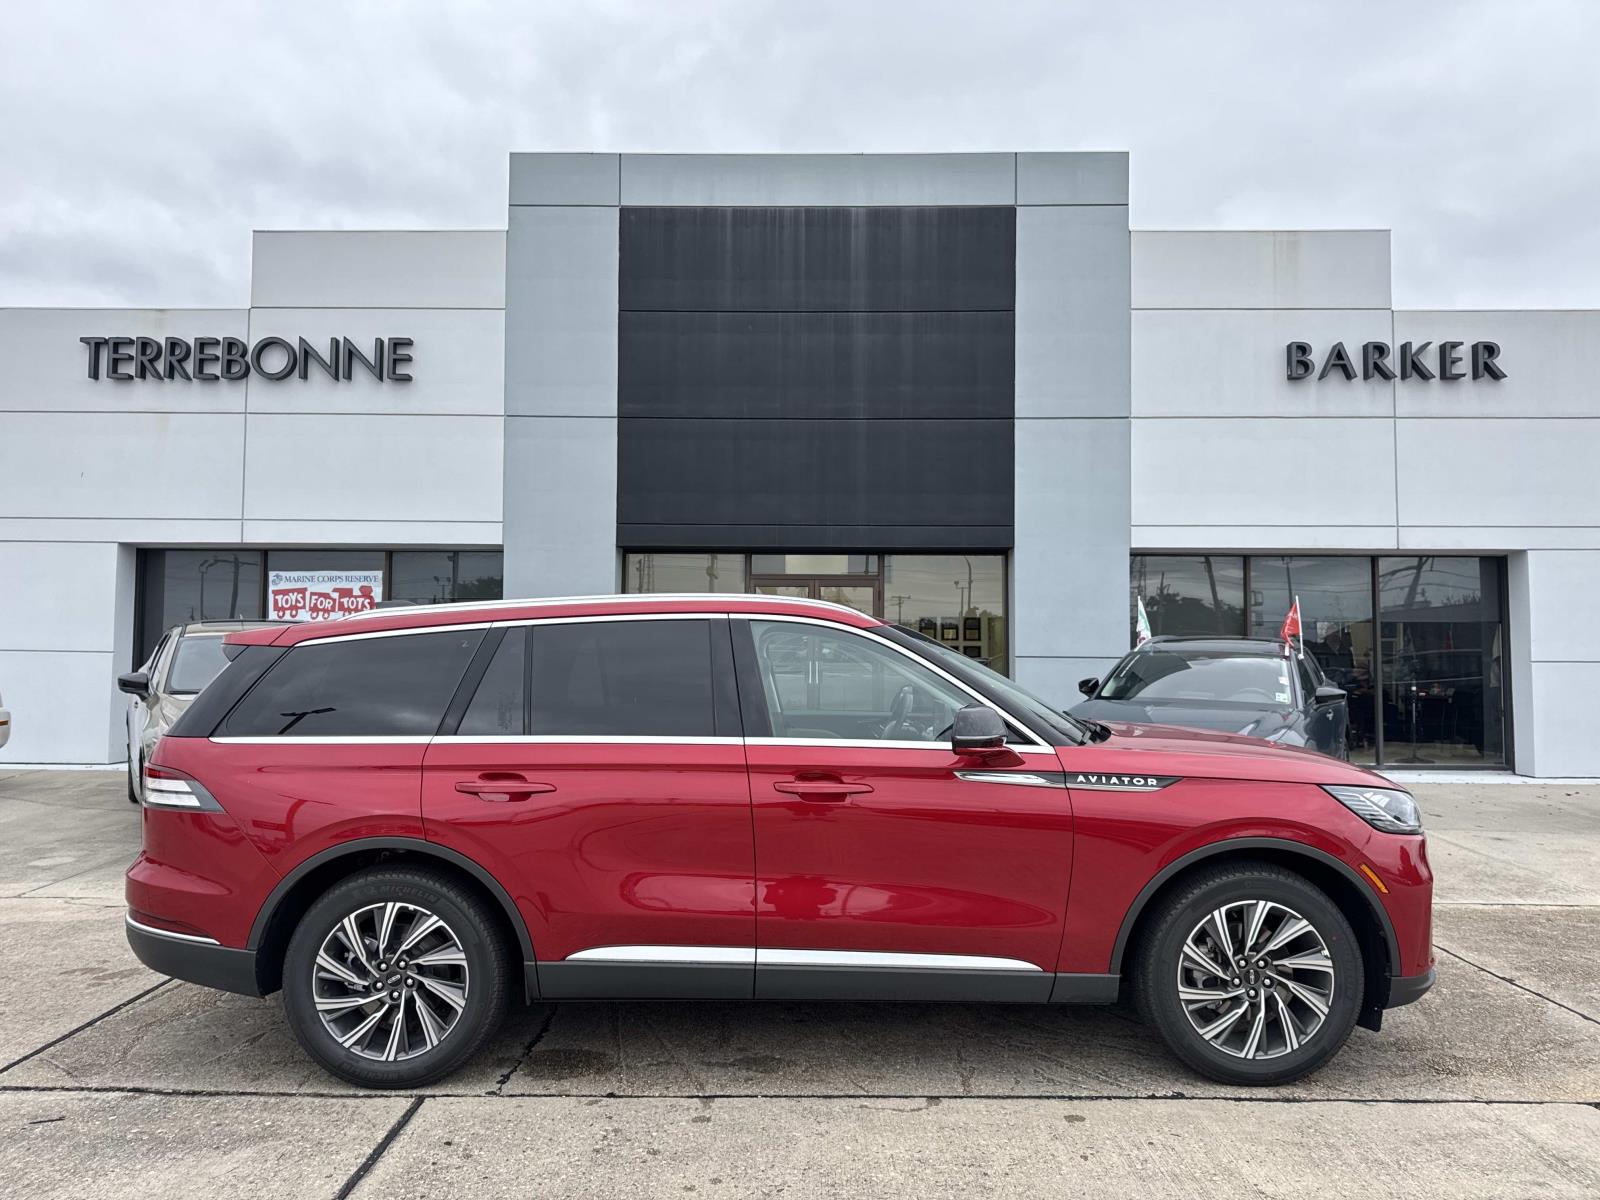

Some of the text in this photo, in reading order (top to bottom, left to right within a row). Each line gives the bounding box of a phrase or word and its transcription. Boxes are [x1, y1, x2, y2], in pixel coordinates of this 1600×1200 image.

[80, 336, 414, 381] TERREBONNE
[1286, 341, 1508, 381] BARKER
[284, 574, 379, 583] MARINE CORPS RESERVE
[275, 592, 371, 610] TOYS FOR TOTS
[1076, 774, 1157, 786] AVIATOR
[381, 885, 440, 903] MICHELIN
